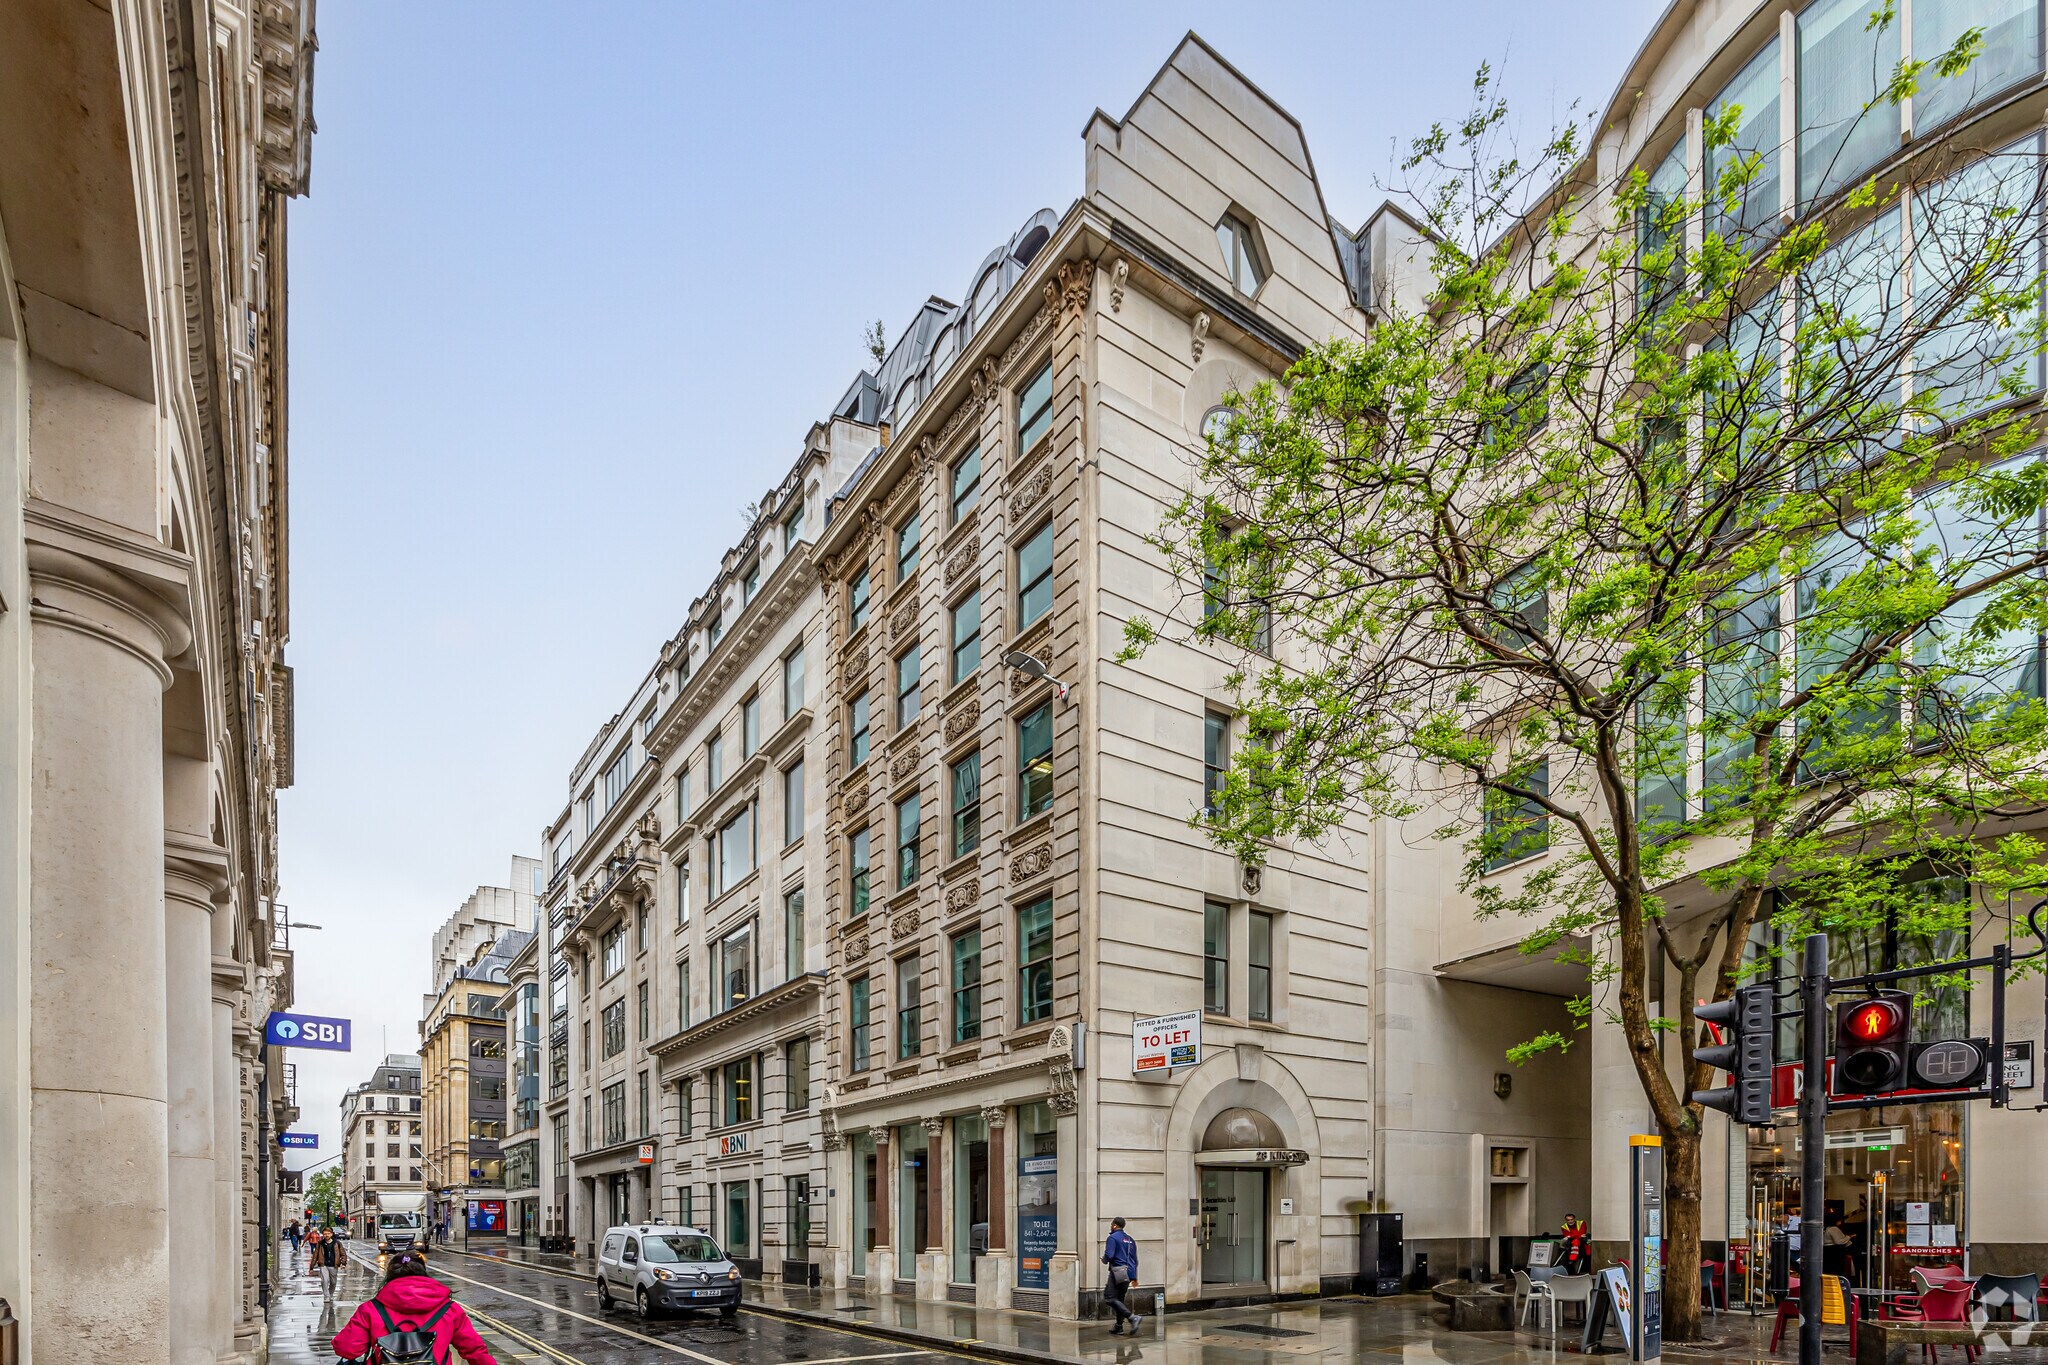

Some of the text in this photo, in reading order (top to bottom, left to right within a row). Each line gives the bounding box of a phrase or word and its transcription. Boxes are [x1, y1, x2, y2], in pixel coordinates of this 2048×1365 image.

[1162, 1014, 1196, 1024] FURNISHED
[302, 1022, 343, 1043] SBI
[1153, 1024, 1178, 1032] OFFICES
[1142, 1030, 1190, 1048] TO LET
[730, 1133, 747, 1153] BNI
[1270, 1152, 1292, 1160] KING
[282, 1178, 299, 1192] 14
